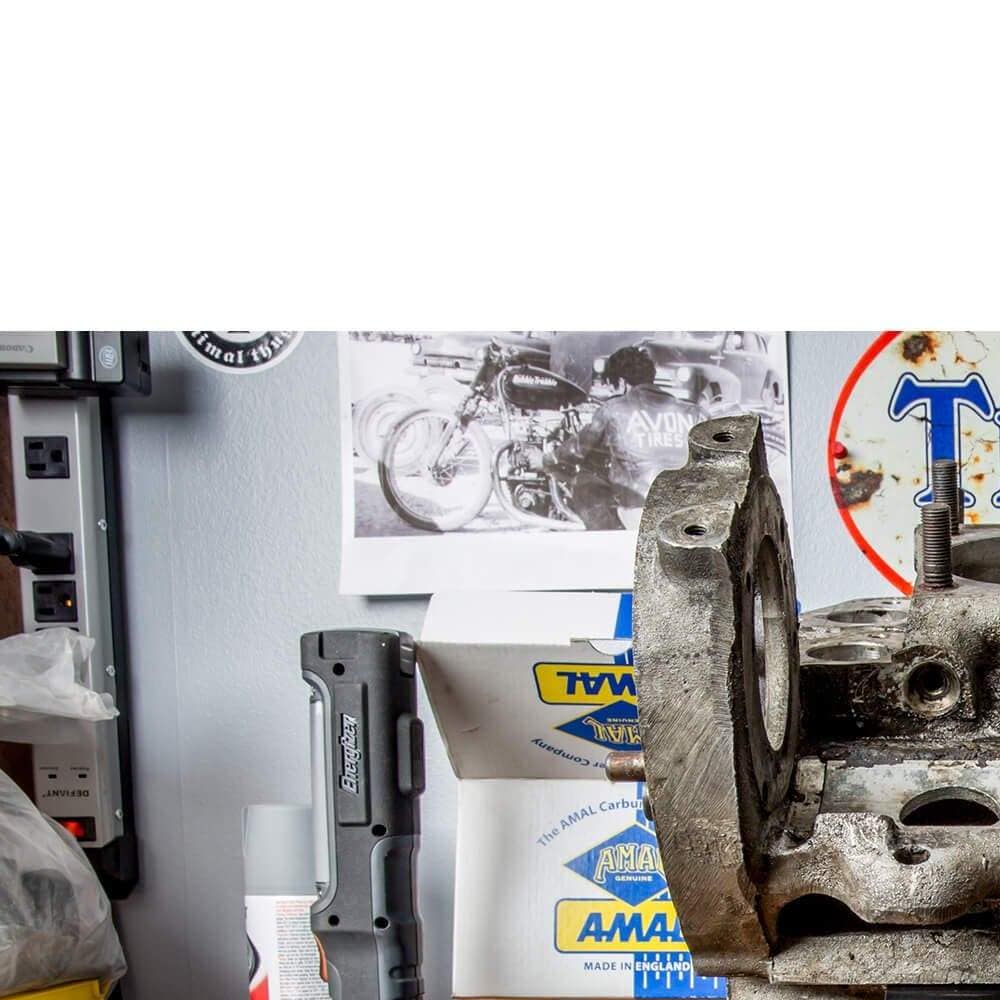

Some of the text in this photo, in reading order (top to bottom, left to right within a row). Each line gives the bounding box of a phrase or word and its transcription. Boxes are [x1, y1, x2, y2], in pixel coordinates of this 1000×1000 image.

[191, 331, 246, 364] imal
[626, 410, 694, 433] AVON
[633, 432, 683, 449] TIRES
[556, 671, 638, 696] MAL
[581, 716, 641, 744] MAL
[340, 713, 361, 794] Energizer
[531, 738, 590, 766] Company
[46, 789, 90, 798] DEFIANT
[536, 827, 560, 847] The
[560, 805, 597, 830] AMAL
[584, 961, 691, 972] MADE IN ENGLAND
